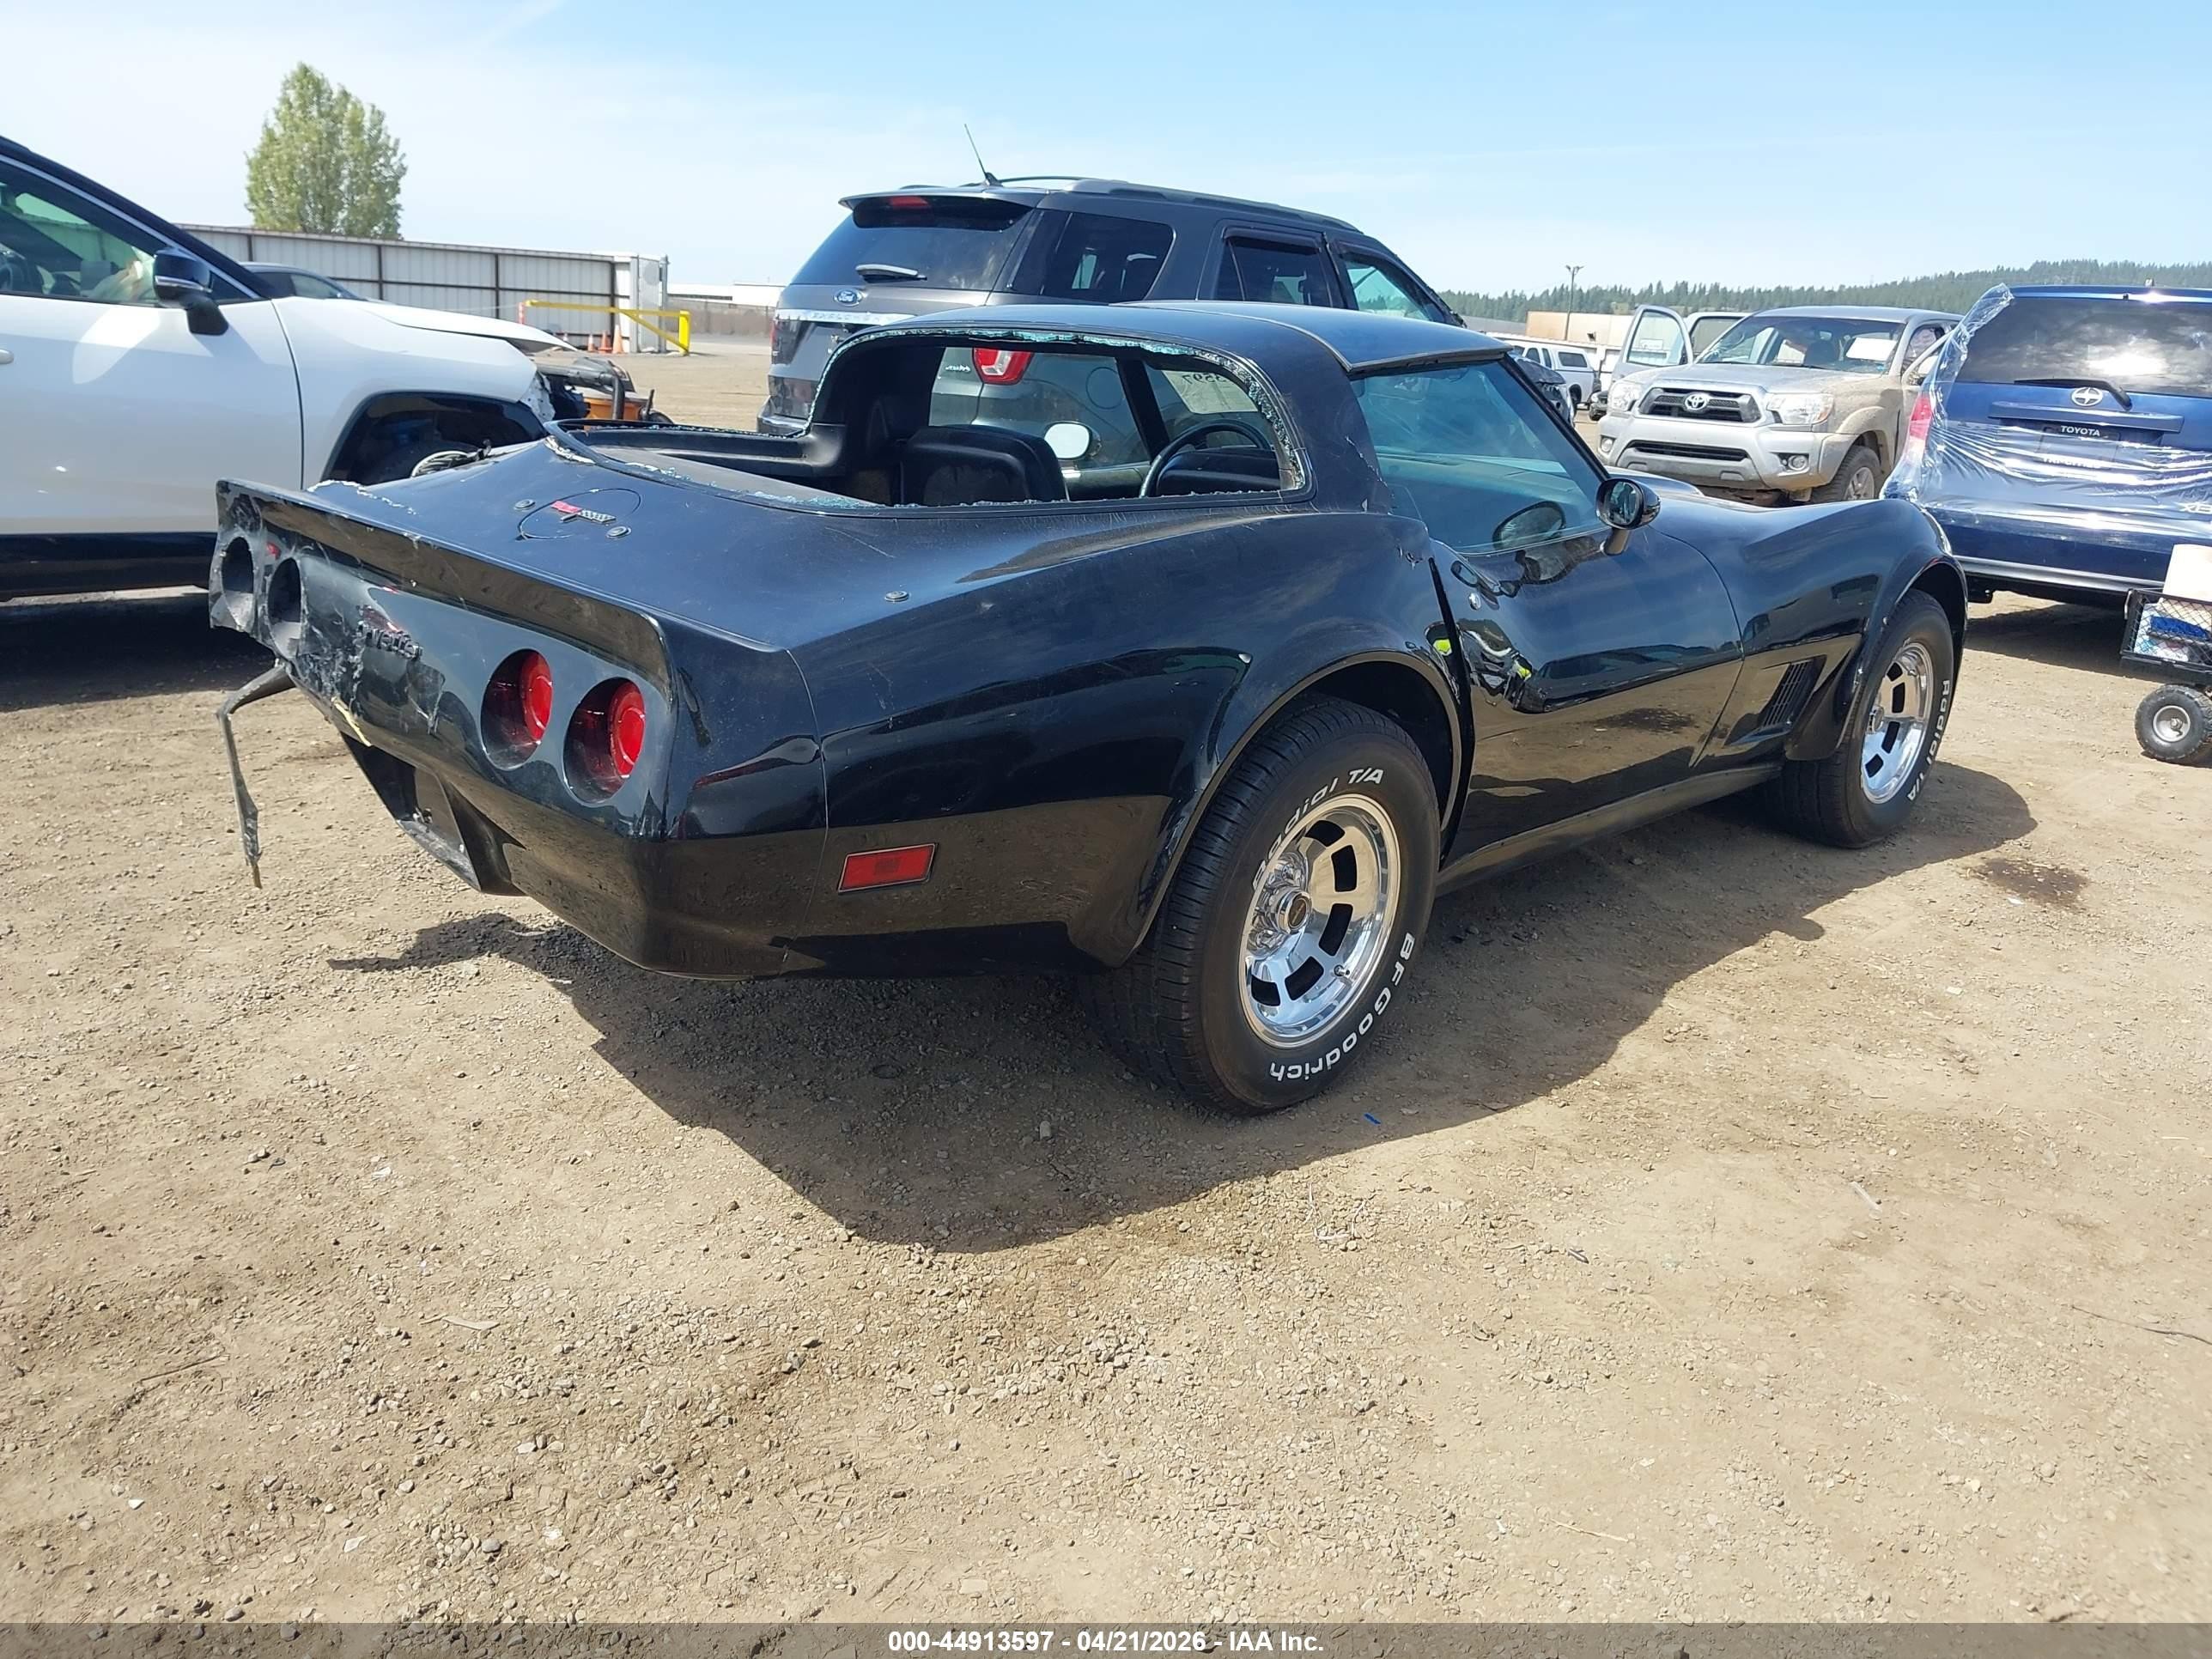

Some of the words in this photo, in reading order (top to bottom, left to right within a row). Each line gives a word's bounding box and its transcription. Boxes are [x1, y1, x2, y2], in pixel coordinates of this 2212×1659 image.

[2061, 425, 2100, 436] TOYOTA
[1348, 768, 1384, 784] T/A
[1269, 932, 1415, 1082] BFGoodrich
